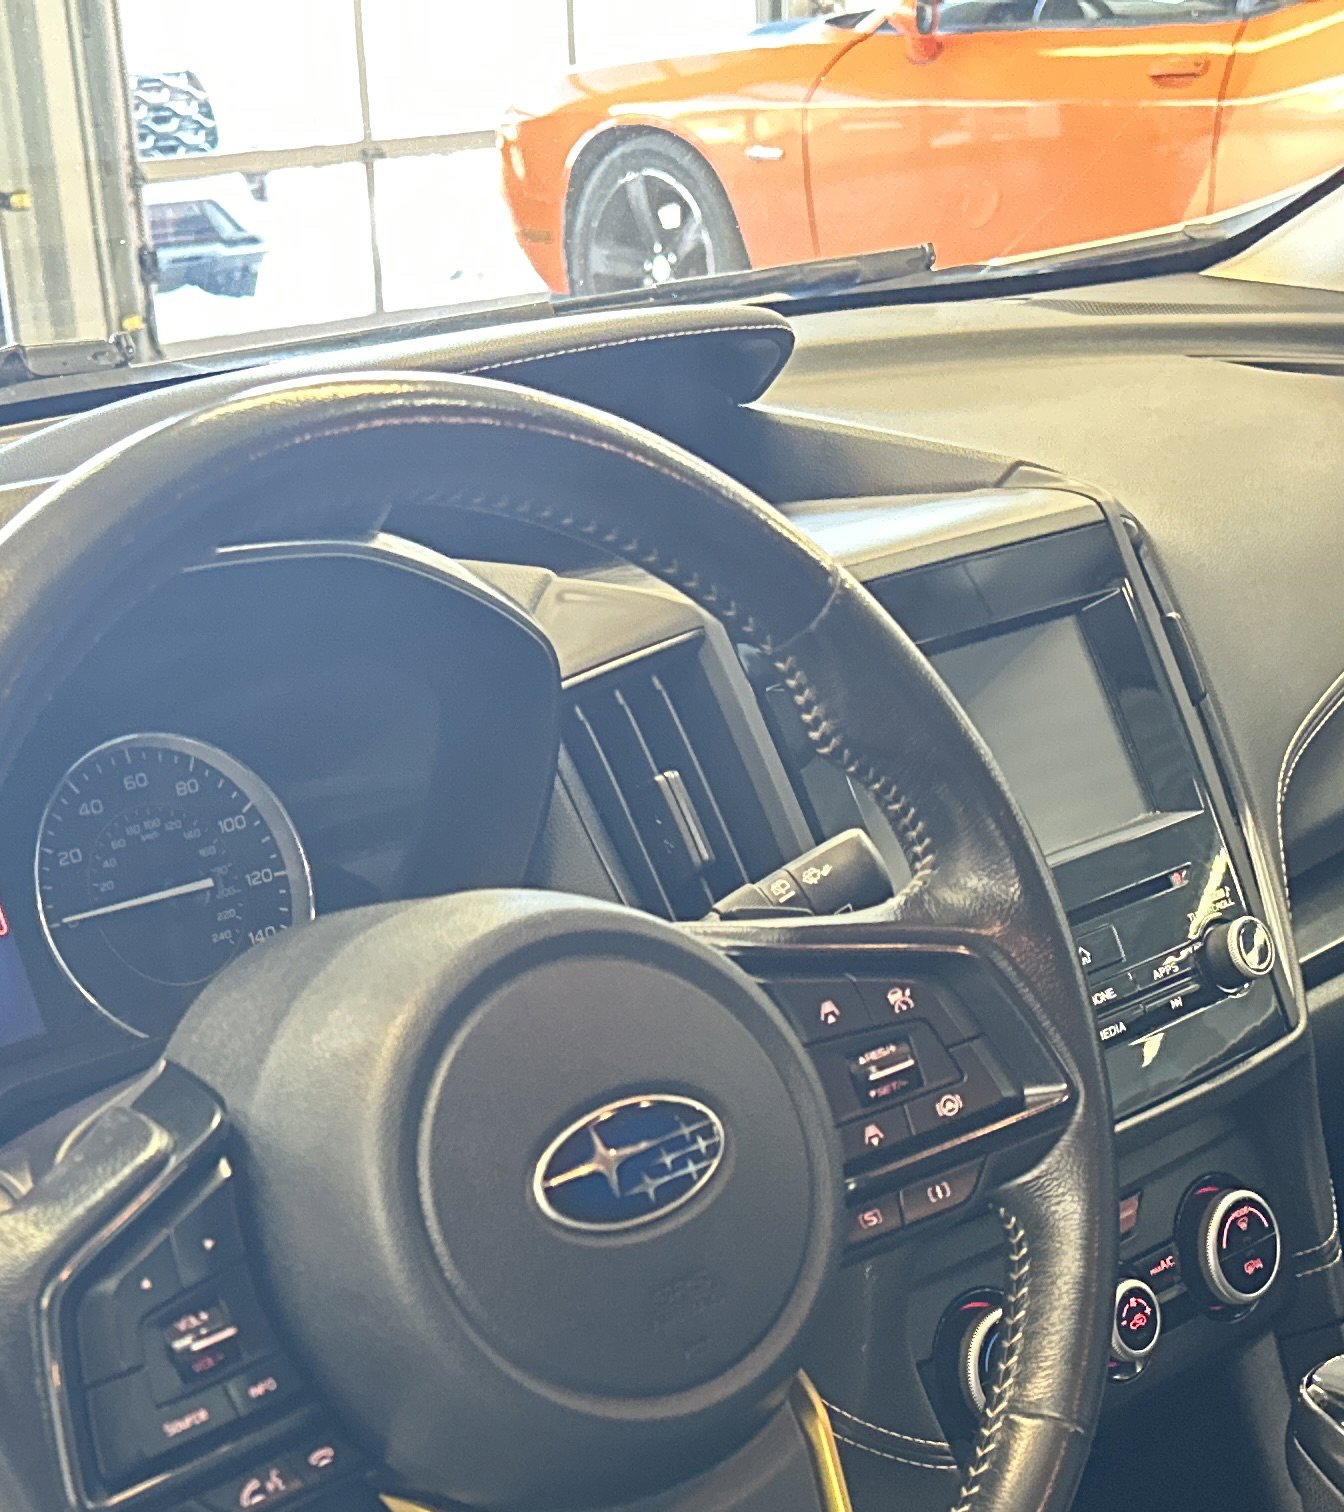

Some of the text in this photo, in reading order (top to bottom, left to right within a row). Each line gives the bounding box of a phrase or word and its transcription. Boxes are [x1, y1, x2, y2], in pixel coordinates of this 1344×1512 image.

[123, 772, 149, 791] 60
[175, 779, 199, 797] 80
[78, 799, 104, 816] 40
[218, 815, 247, 834] 100
[57, 848, 83, 867] 20
[244, 868, 274, 887] 120
[248, 925, 276, 945] 140
[1153, 963, 1180, 981] APPS
